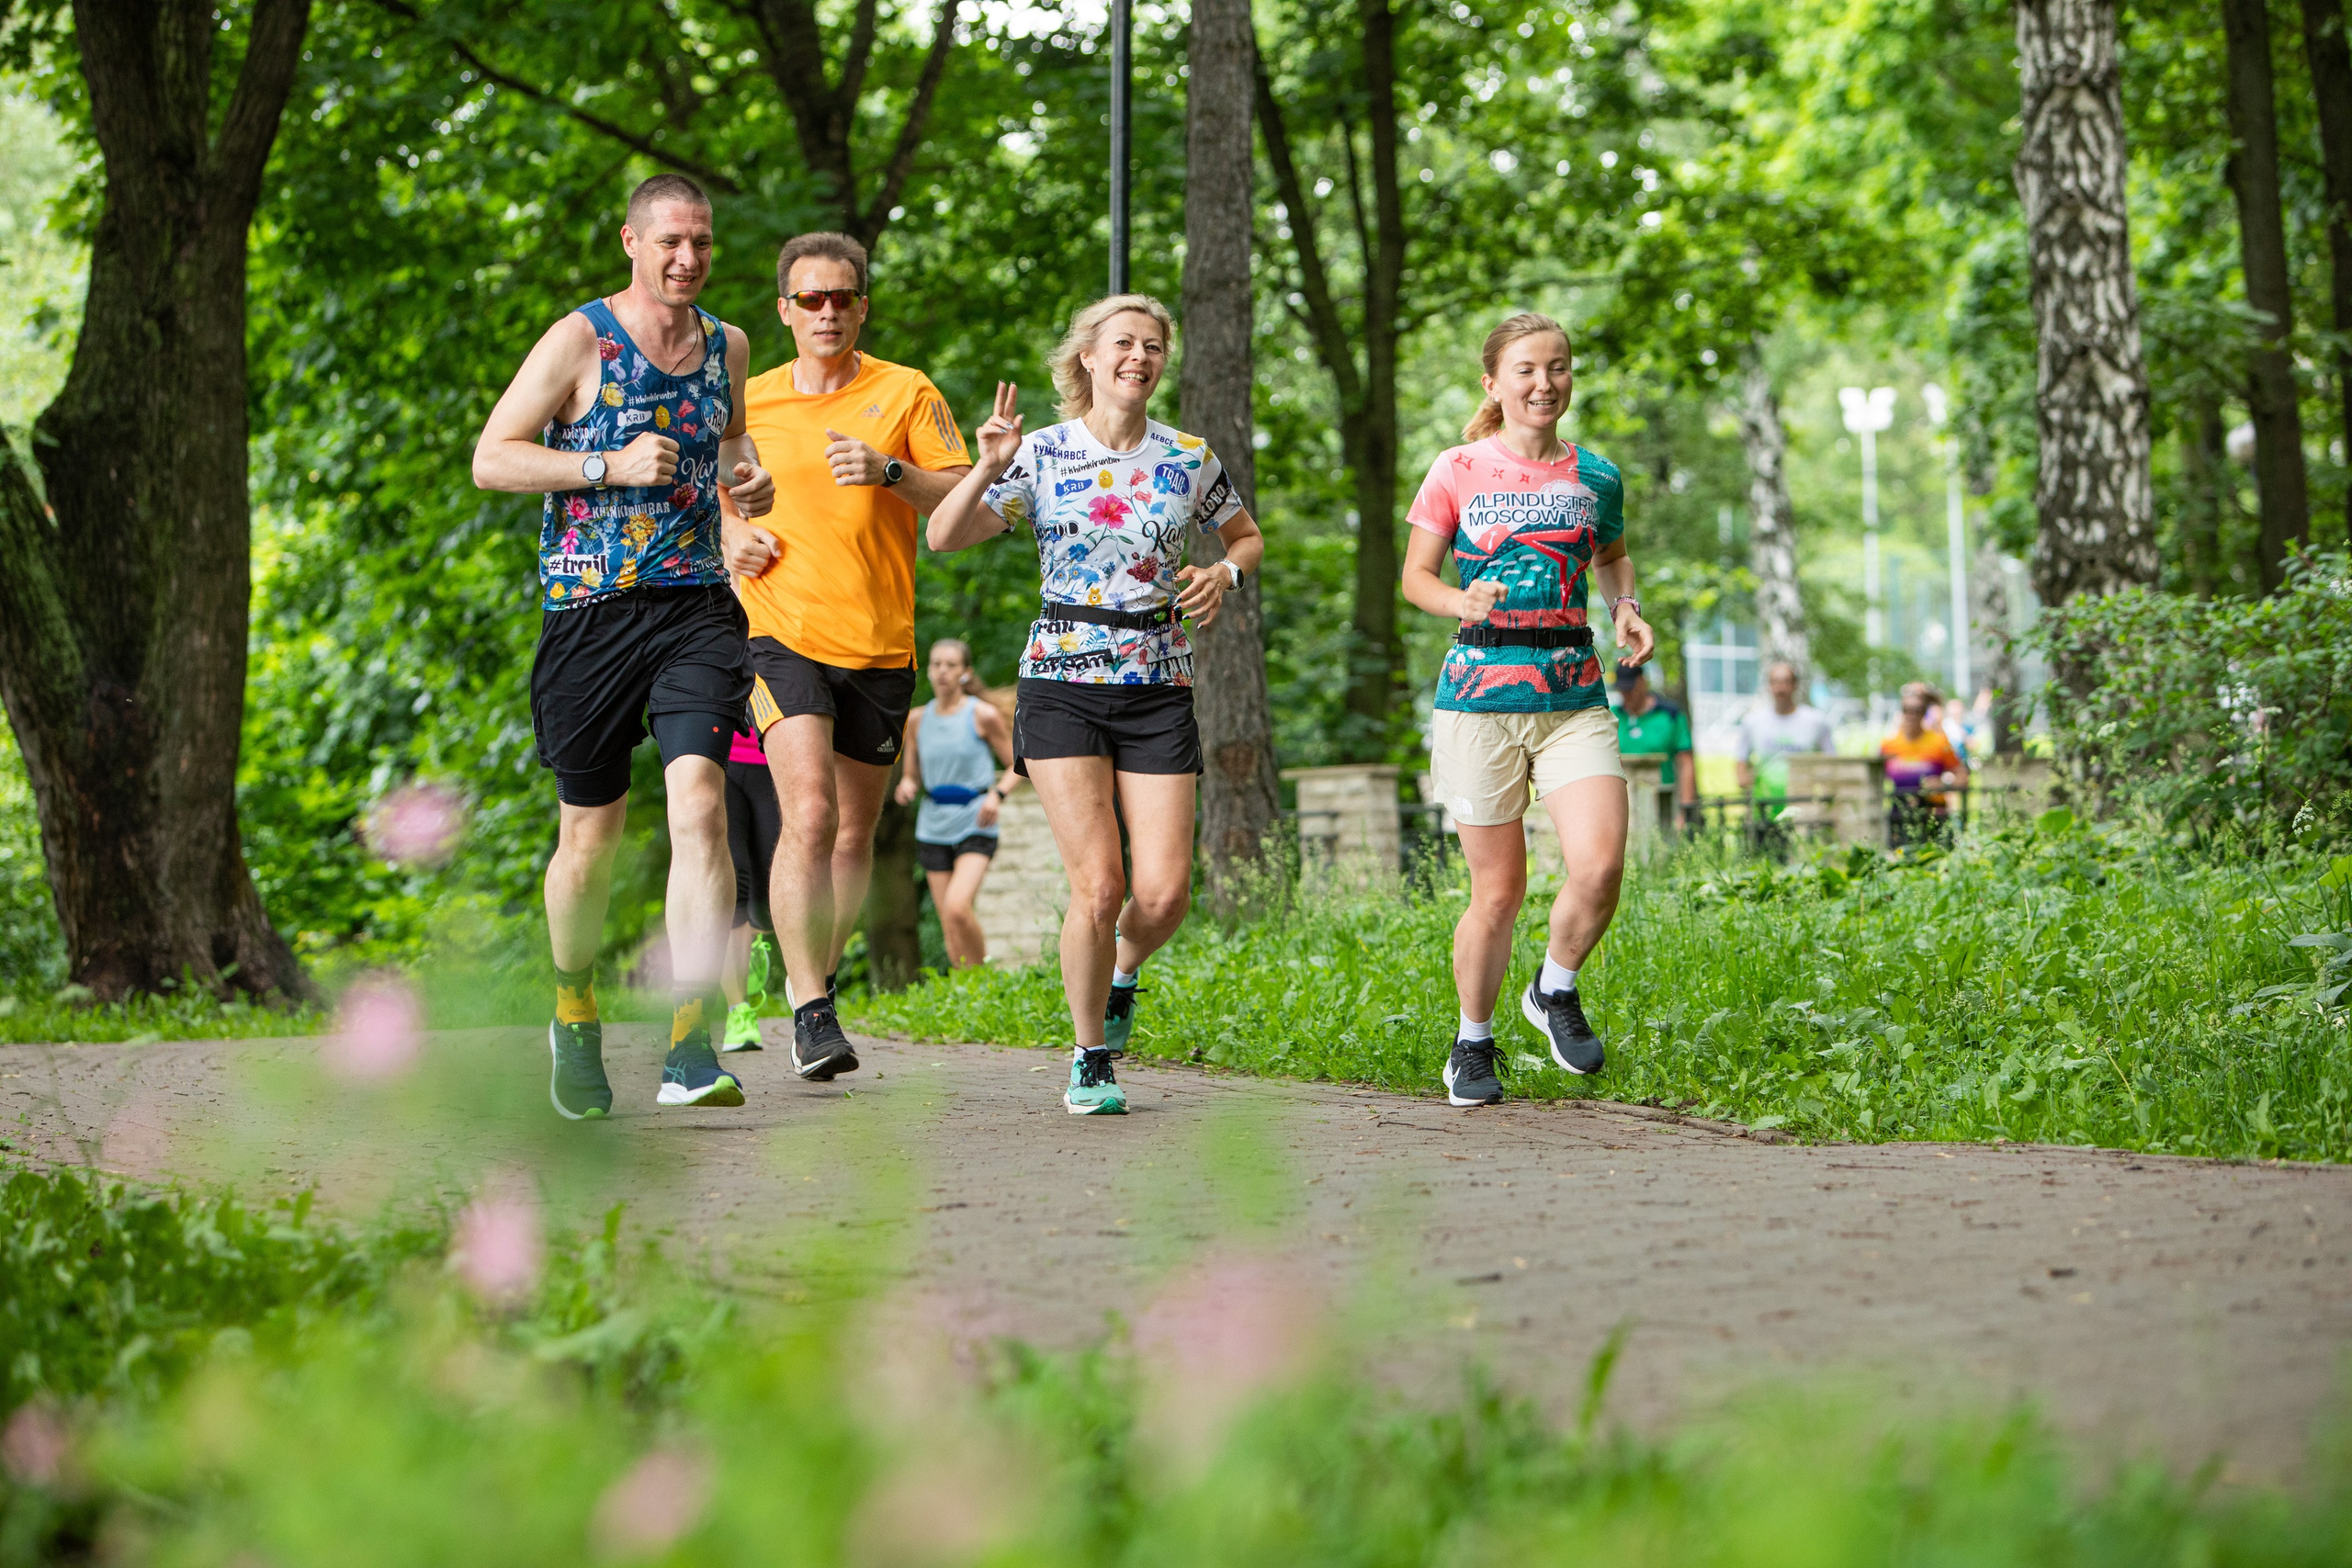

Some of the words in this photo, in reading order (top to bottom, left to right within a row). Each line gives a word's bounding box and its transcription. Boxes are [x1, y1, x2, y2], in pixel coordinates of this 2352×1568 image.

[626, 413, 646, 422] KRB
[1034, 444, 1087, 460] #УМЕНЯВСЕ
[1063, 481, 1085, 492] KRB
[1162, 466, 1186, 495] TRAIL
[1469, 509, 1560, 527] MOSCOW
[549, 554, 607, 574] #trail
